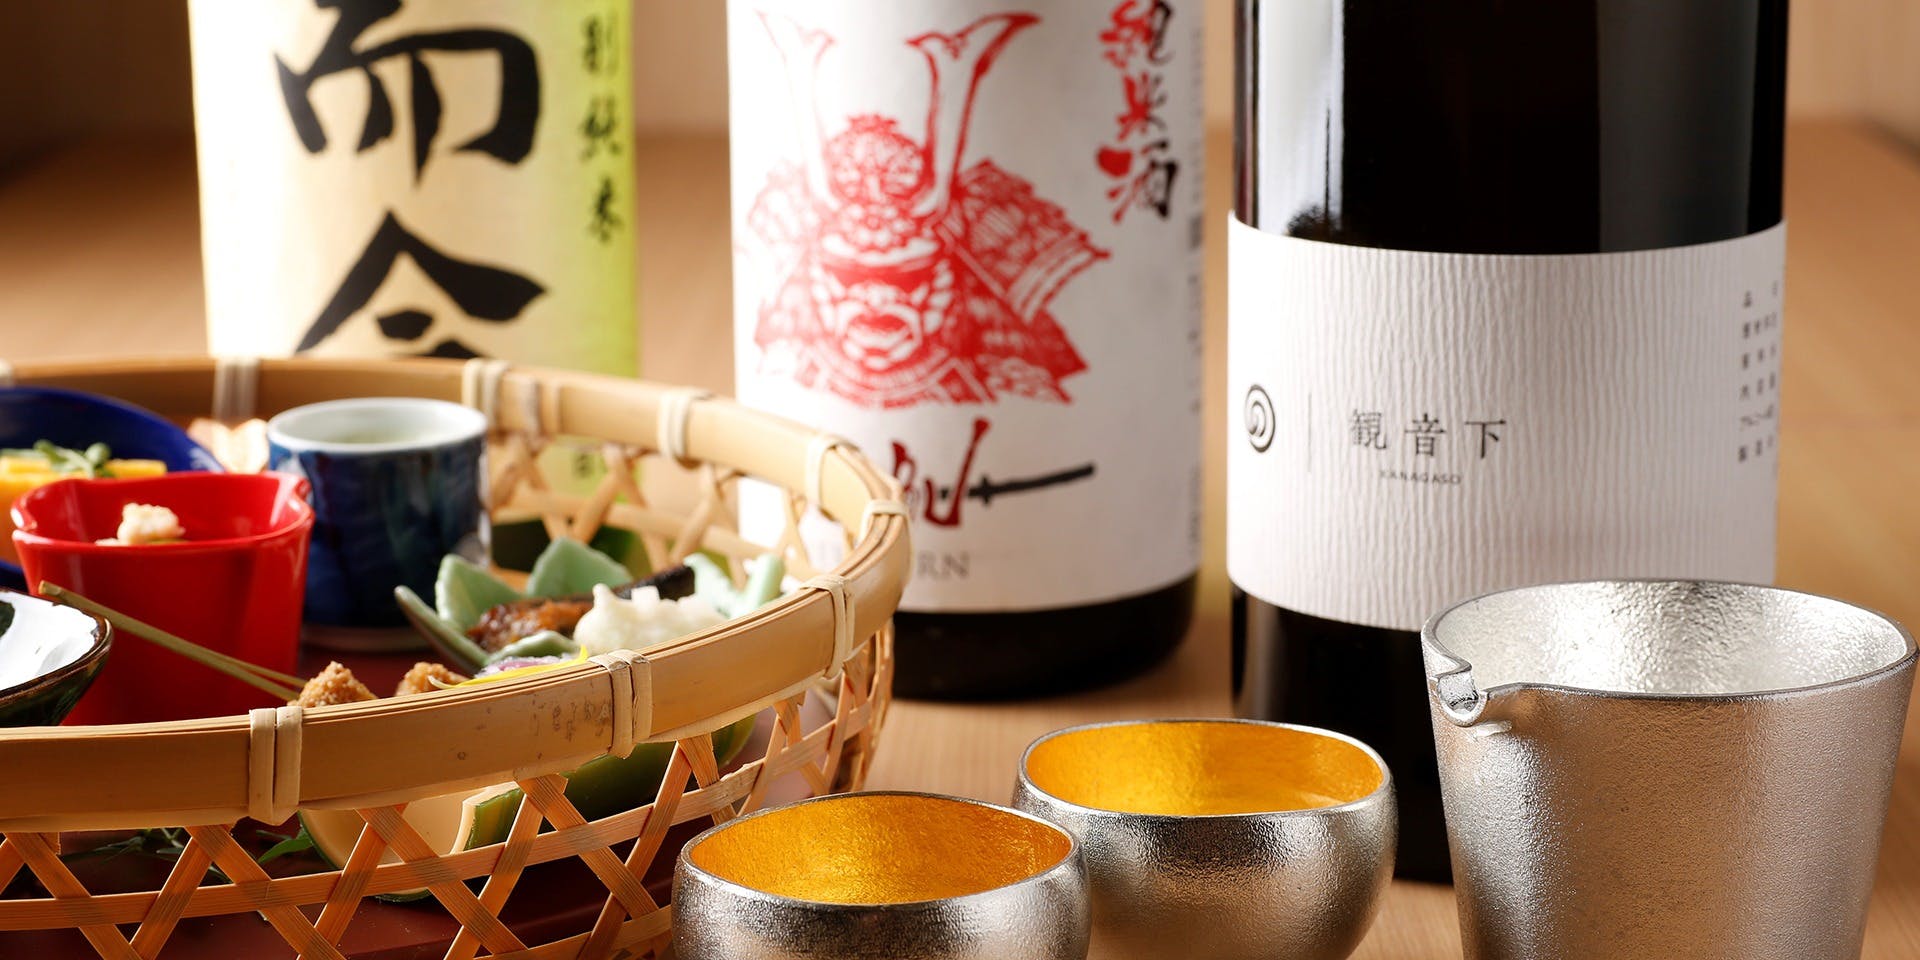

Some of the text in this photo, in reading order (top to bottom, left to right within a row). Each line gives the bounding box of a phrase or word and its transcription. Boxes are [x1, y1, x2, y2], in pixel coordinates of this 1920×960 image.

[274, 0, 547, 357] 而今
[1096, 0, 1179, 224] 純米酒
[1348, 408, 1507, 460] 観音下
[1379, 469, 1463, 486] KANAGASO
